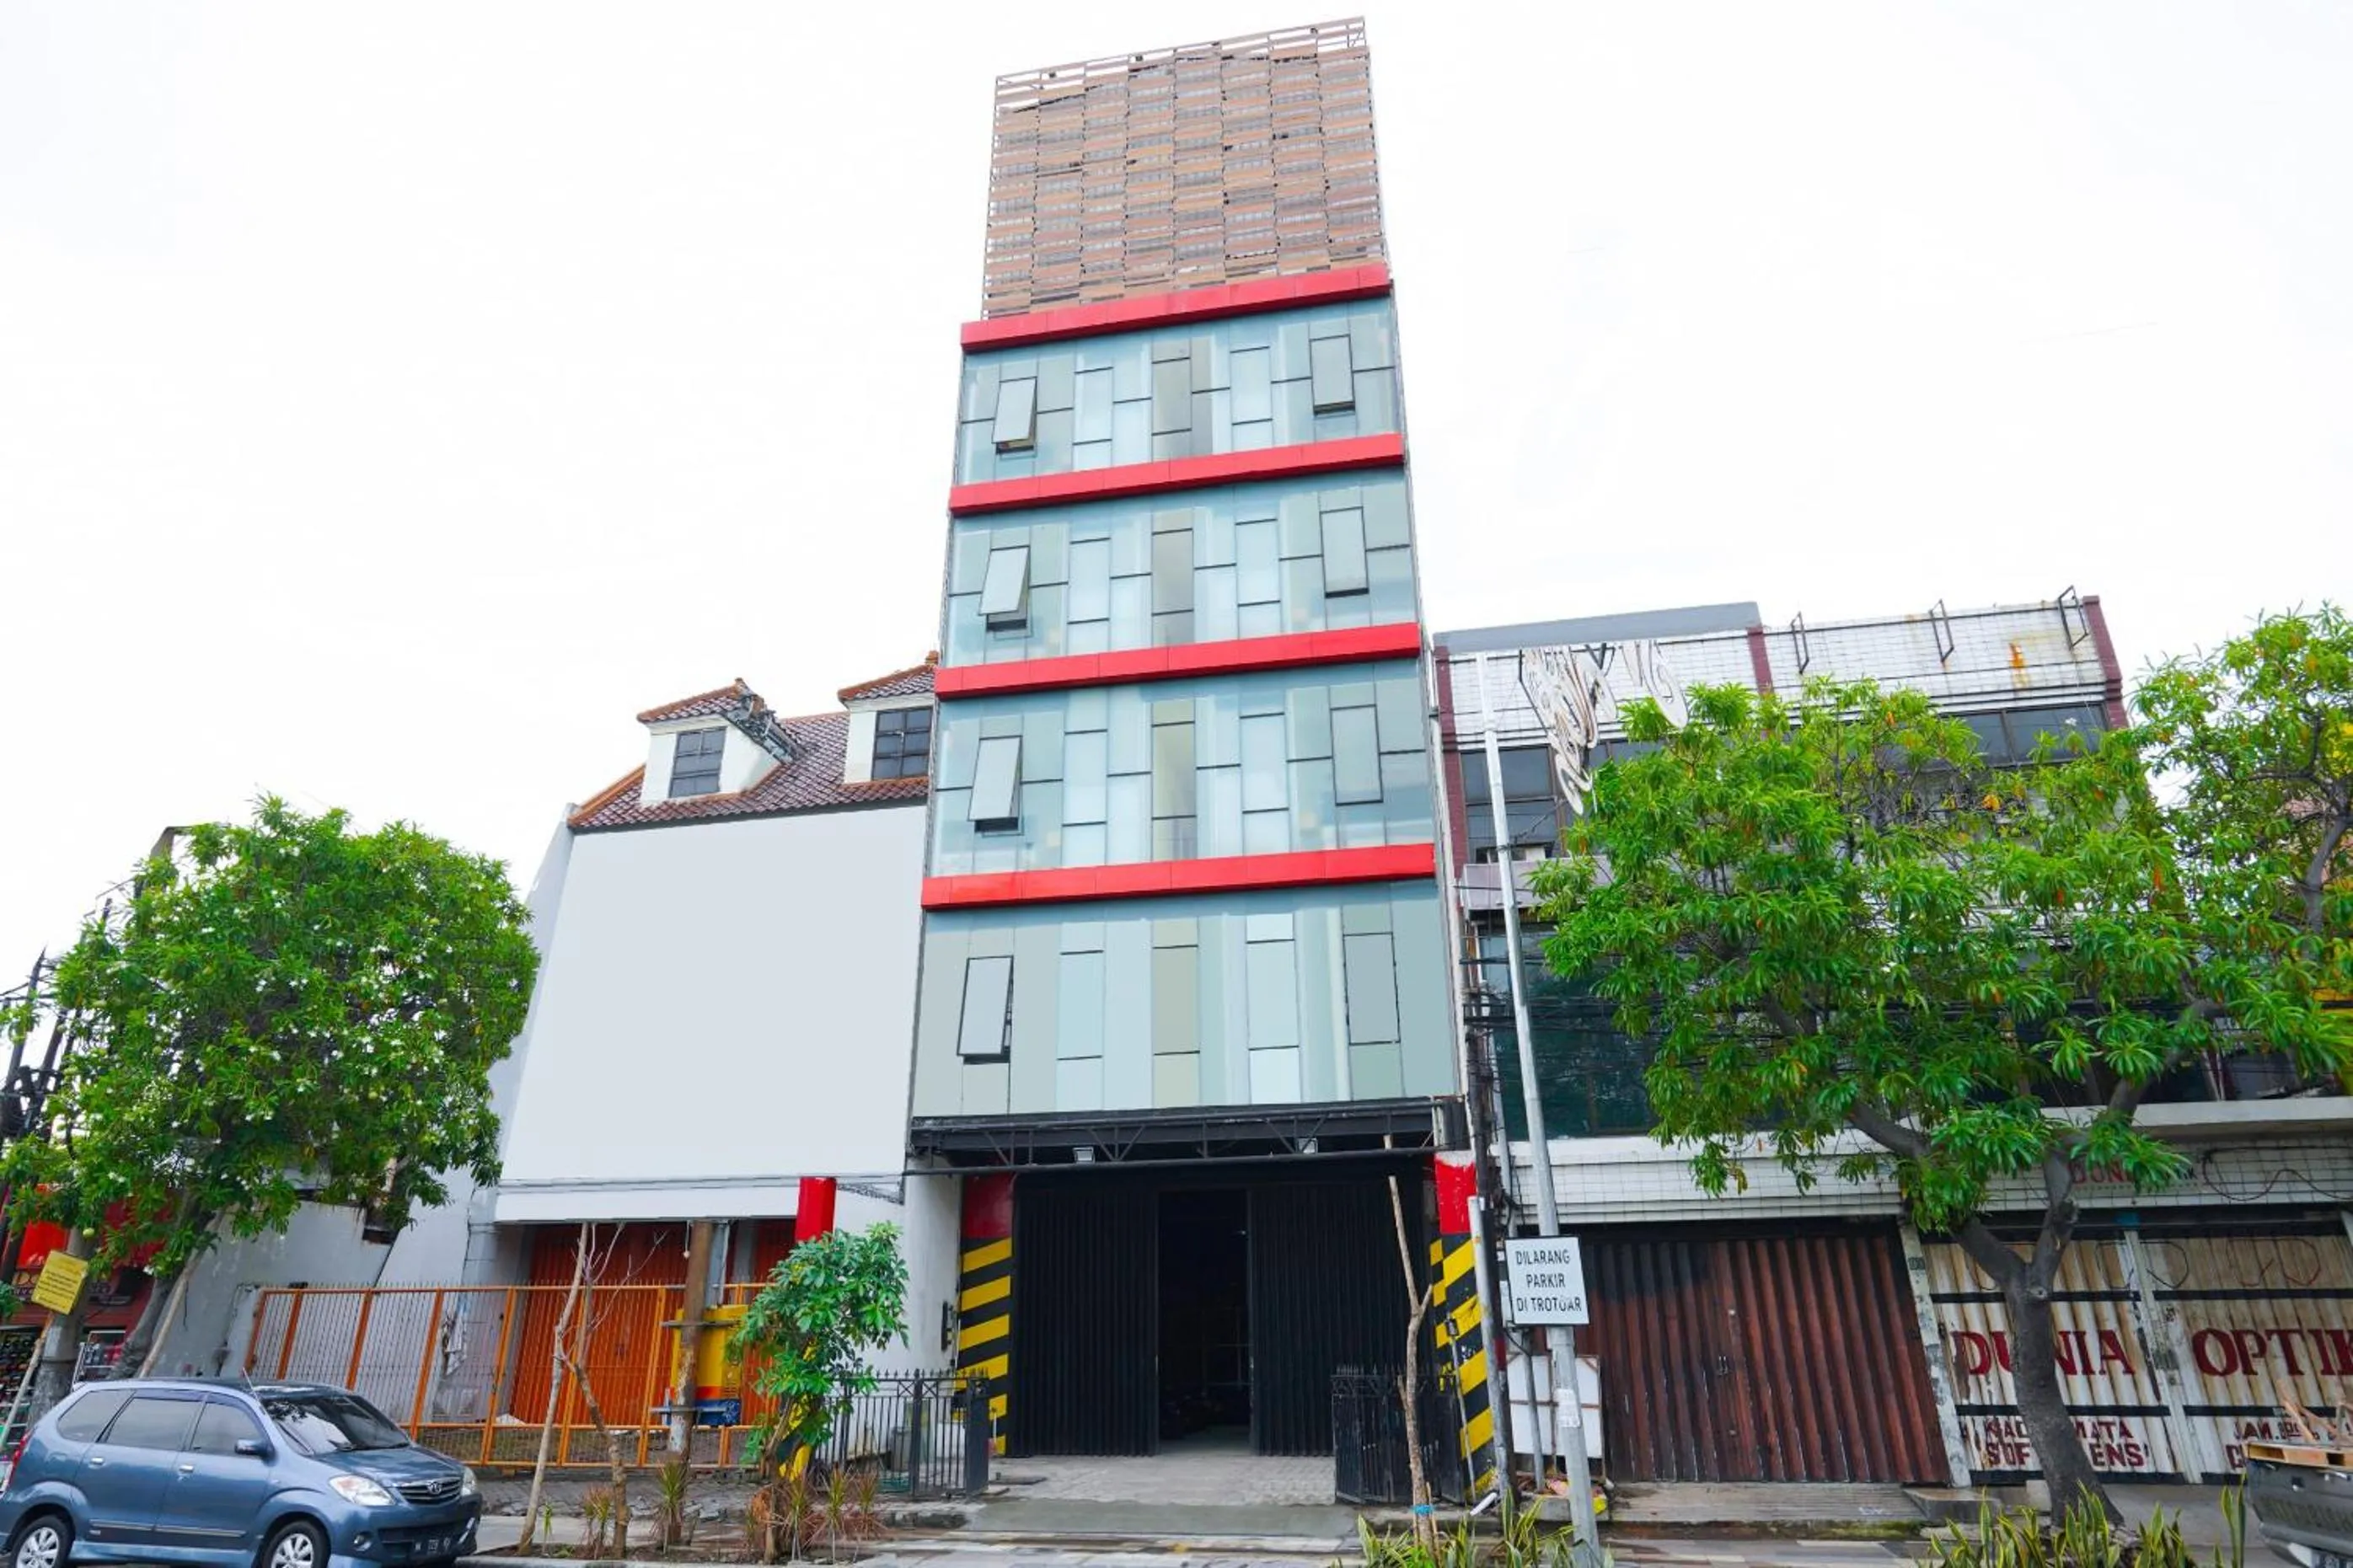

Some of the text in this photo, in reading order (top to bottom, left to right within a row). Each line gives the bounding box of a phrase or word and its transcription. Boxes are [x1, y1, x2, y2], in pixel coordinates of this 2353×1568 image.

[1515, 1249, 1571, 1265] DILARANG
[1526, 1273, 1566, 1288] PARKIR
[1516, 1297, 1582, 1312] DI TROTUAR
[1986, 1442, 2145, 1467] SOF ENS
